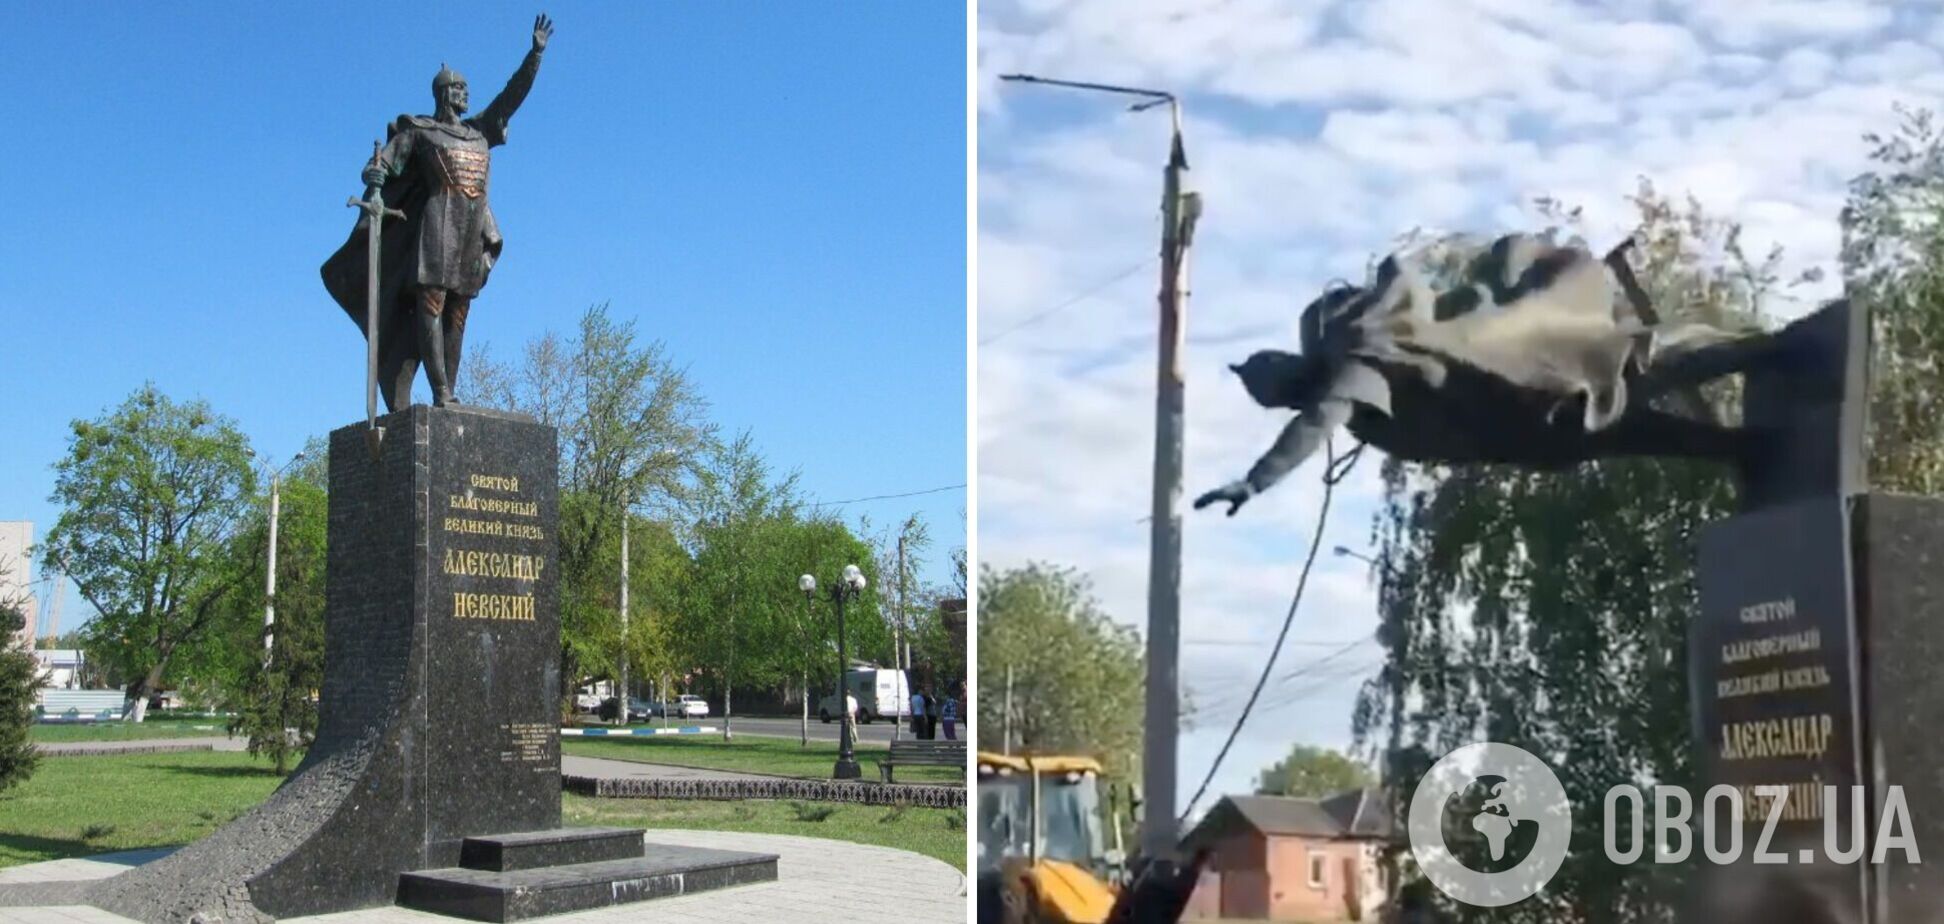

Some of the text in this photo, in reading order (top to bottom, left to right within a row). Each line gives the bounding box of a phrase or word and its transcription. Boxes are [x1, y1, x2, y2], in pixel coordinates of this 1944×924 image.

[471, 474, 518, 492] СВЯТОЙ
[450, 495, 538, 517] БЛАГОВЕРНЫЙ
[444, 518, 544, 540] ВЕЛИКИЙ КНЯЗЬ
[443, 549, 544, 581] АЛЕКСАНДР
[453, 592, 536, 621] НЕВСКИЙ
[1721, 714, 1832, 760] АЛЕКСАНДР
